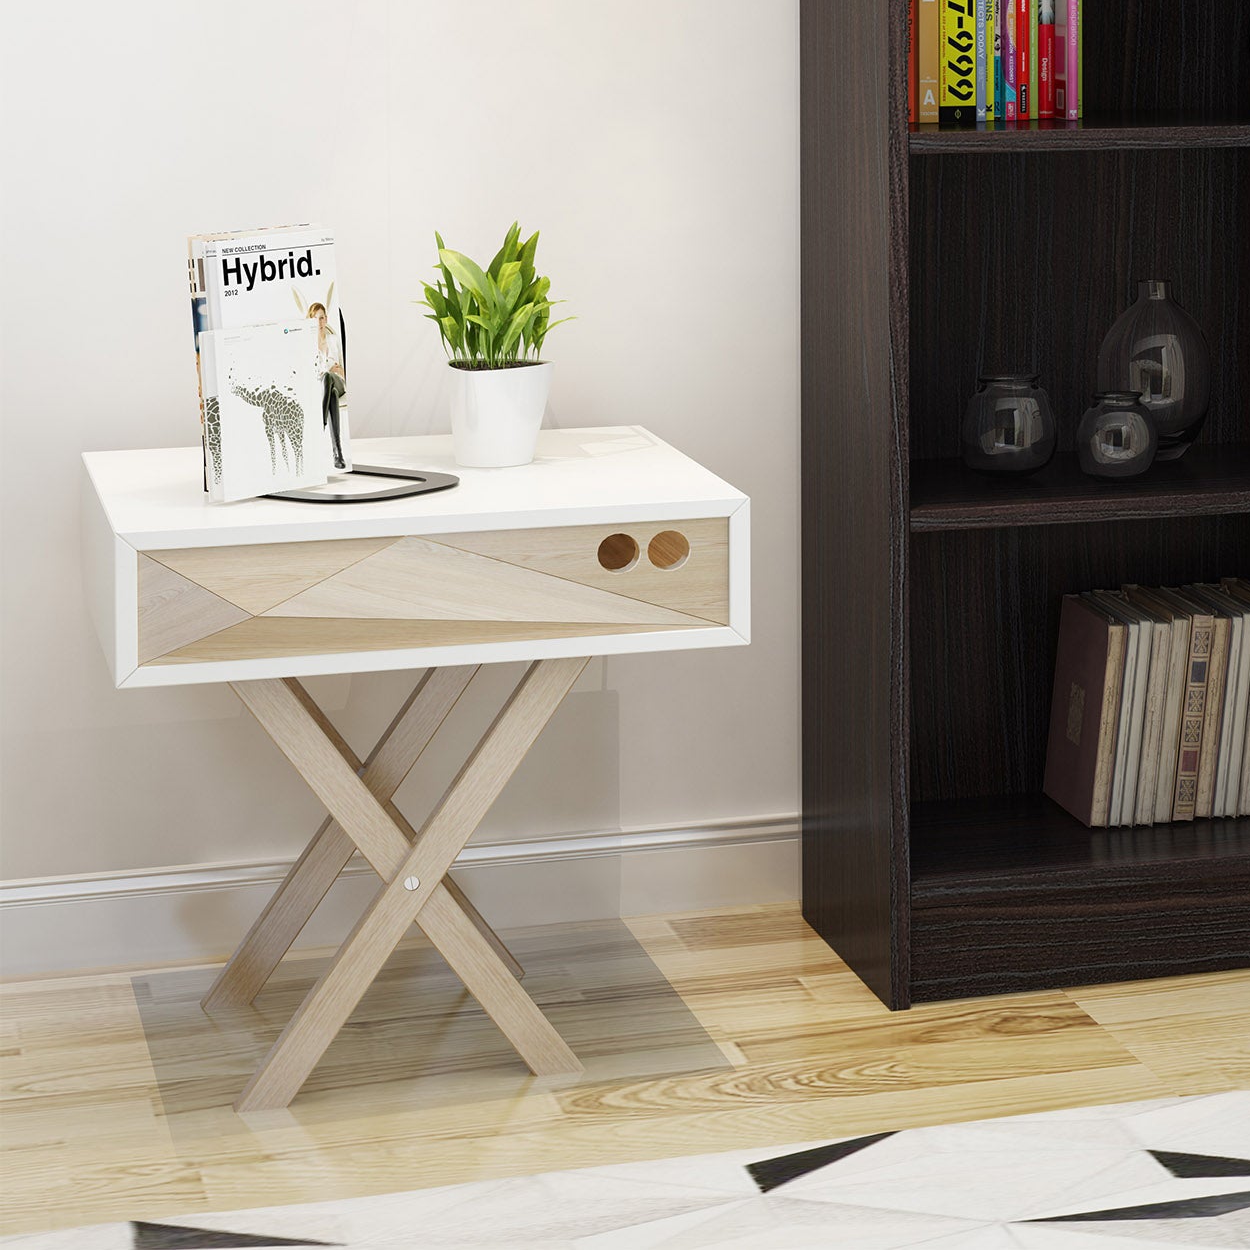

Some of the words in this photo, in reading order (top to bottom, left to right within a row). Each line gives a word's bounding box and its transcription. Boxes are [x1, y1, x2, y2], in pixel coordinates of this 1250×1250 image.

[924, 90, 936, 106] A
[234, 244, 266, 252] COLLECTION
[222, 250, 321, 291] Hybrid.
